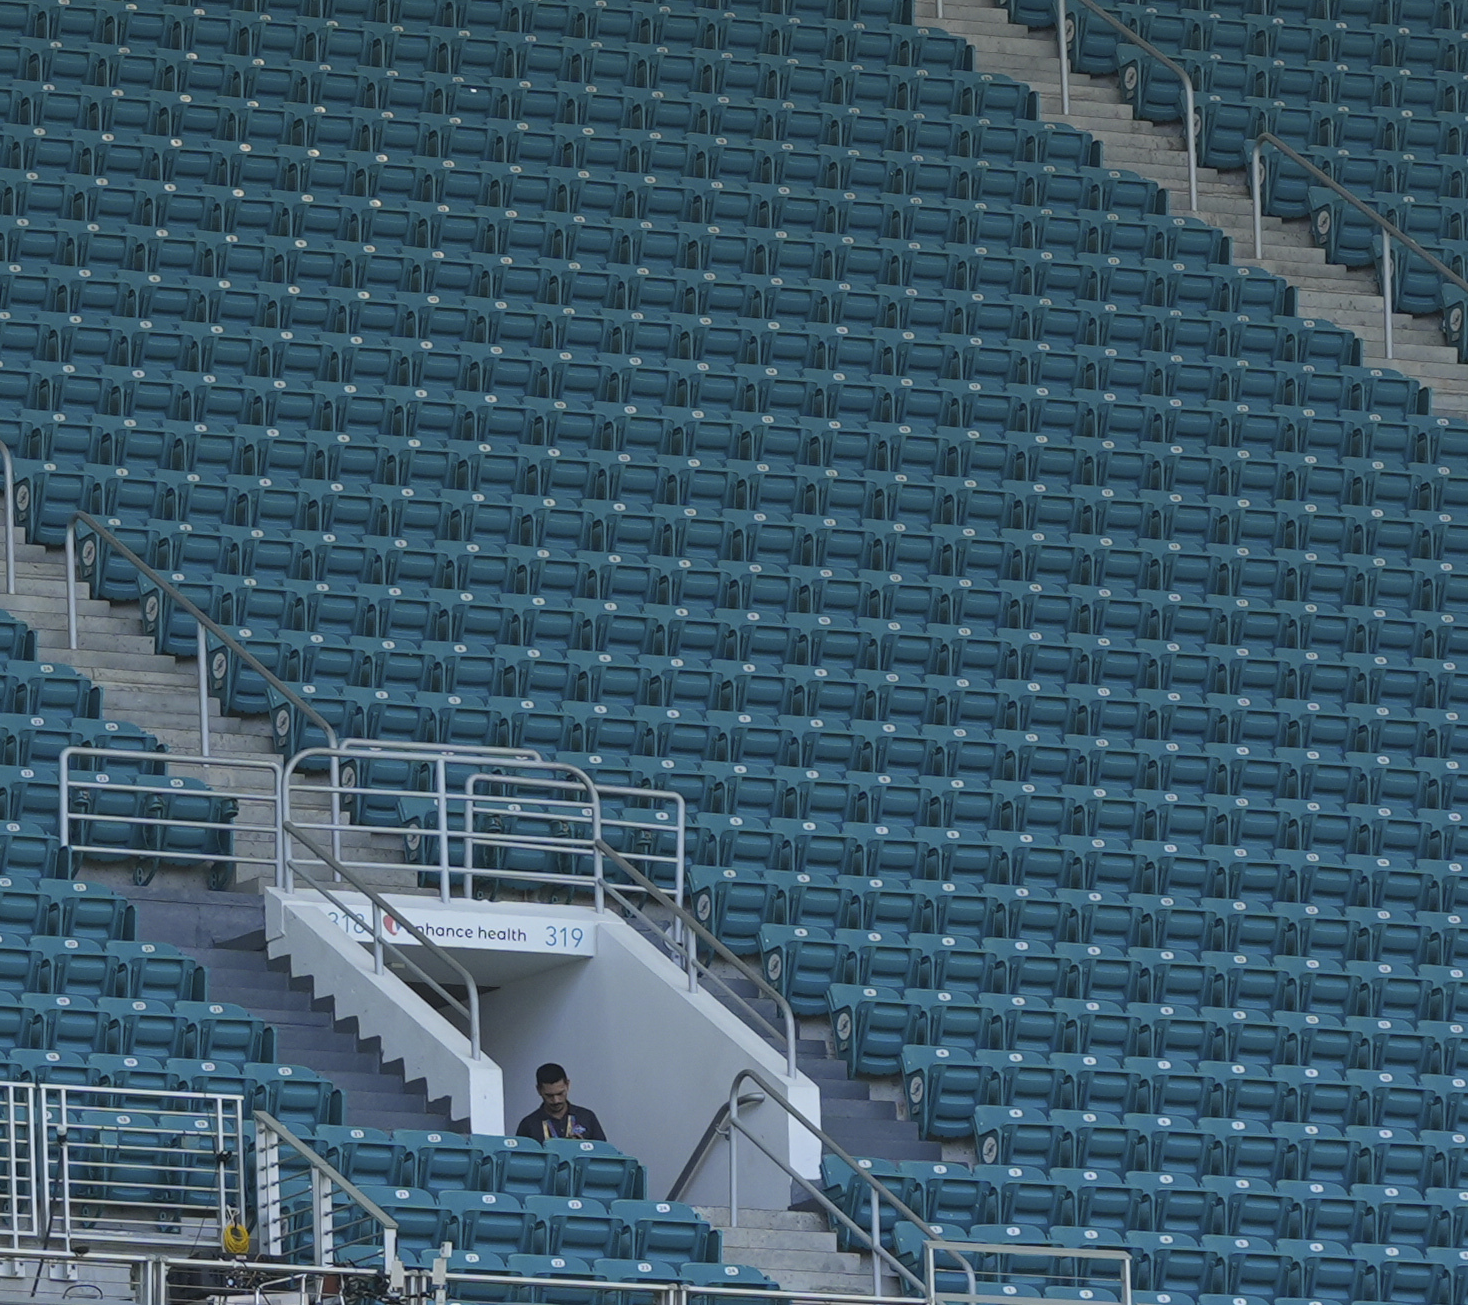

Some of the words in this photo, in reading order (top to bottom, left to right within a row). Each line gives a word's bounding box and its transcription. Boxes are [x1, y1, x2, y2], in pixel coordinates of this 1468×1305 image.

[406, 923, 474, 939] nhance
[478, 926, 527, 942] health
[545, 926, 584, 948] 319
